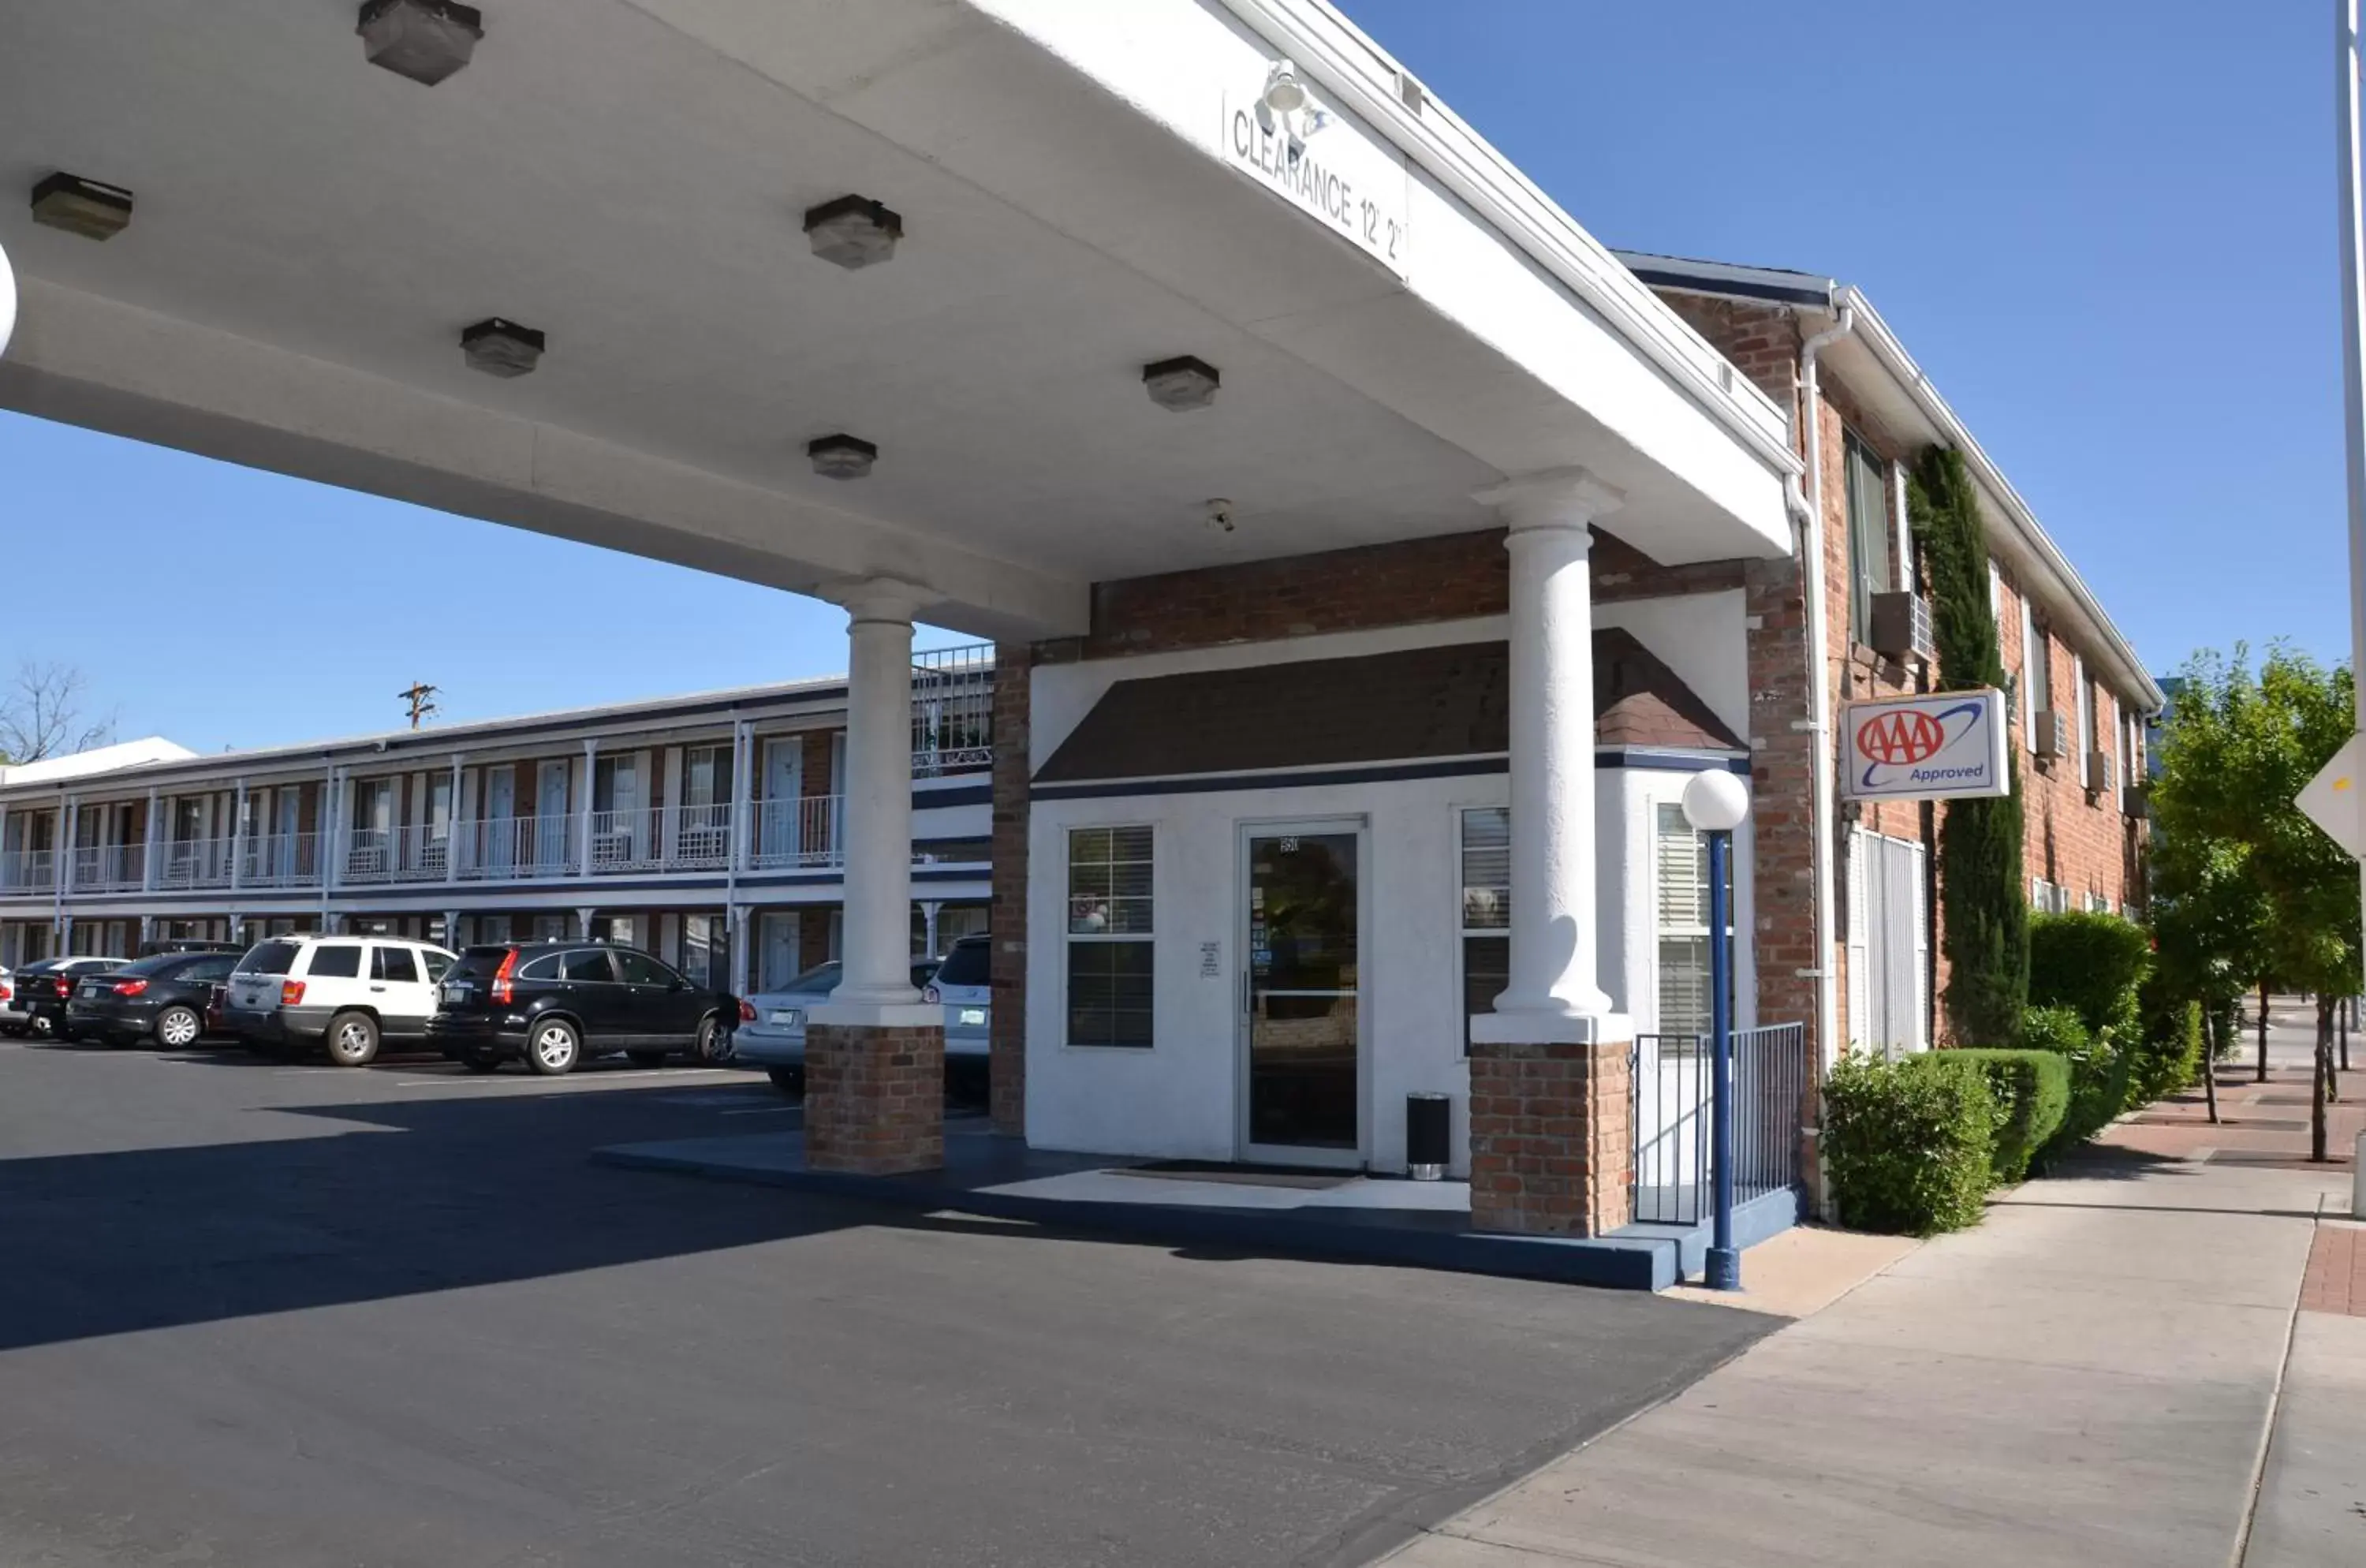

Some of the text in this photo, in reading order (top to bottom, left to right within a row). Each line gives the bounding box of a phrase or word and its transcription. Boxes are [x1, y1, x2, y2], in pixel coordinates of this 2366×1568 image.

[1233, 110, 1351, 227] CLEARANCE
[1868, 711, 1936, 763] AAA
[1910, 763, 1983, 782] Approved
